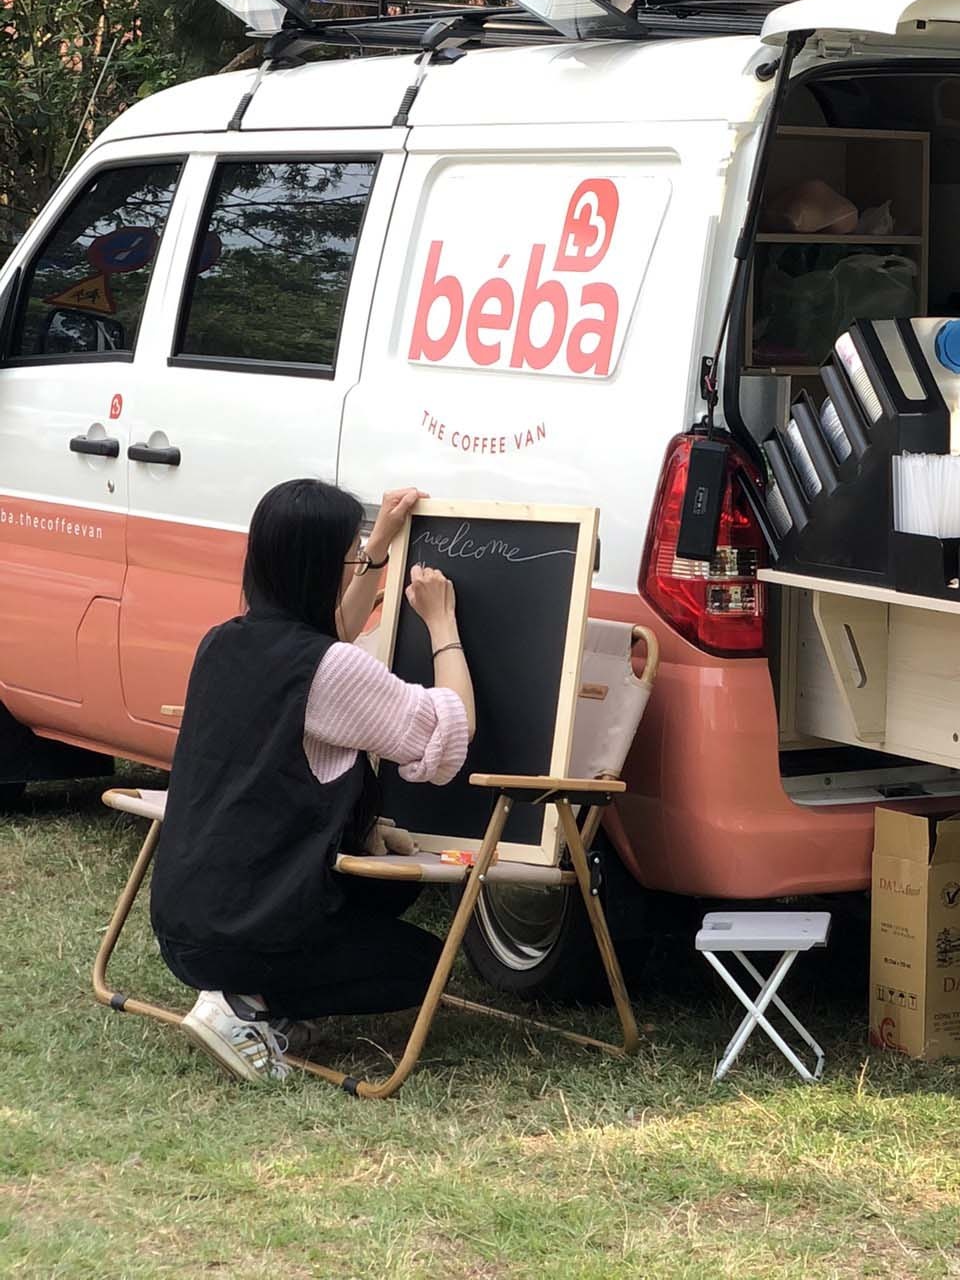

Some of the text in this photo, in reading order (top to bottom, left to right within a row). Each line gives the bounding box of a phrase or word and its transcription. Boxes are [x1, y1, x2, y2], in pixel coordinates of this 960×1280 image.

[408, 240, 620, 376] béba
[421, 410, 546, 454] THE COFFEE VAN
[413, 522, 577, 562] welcome
